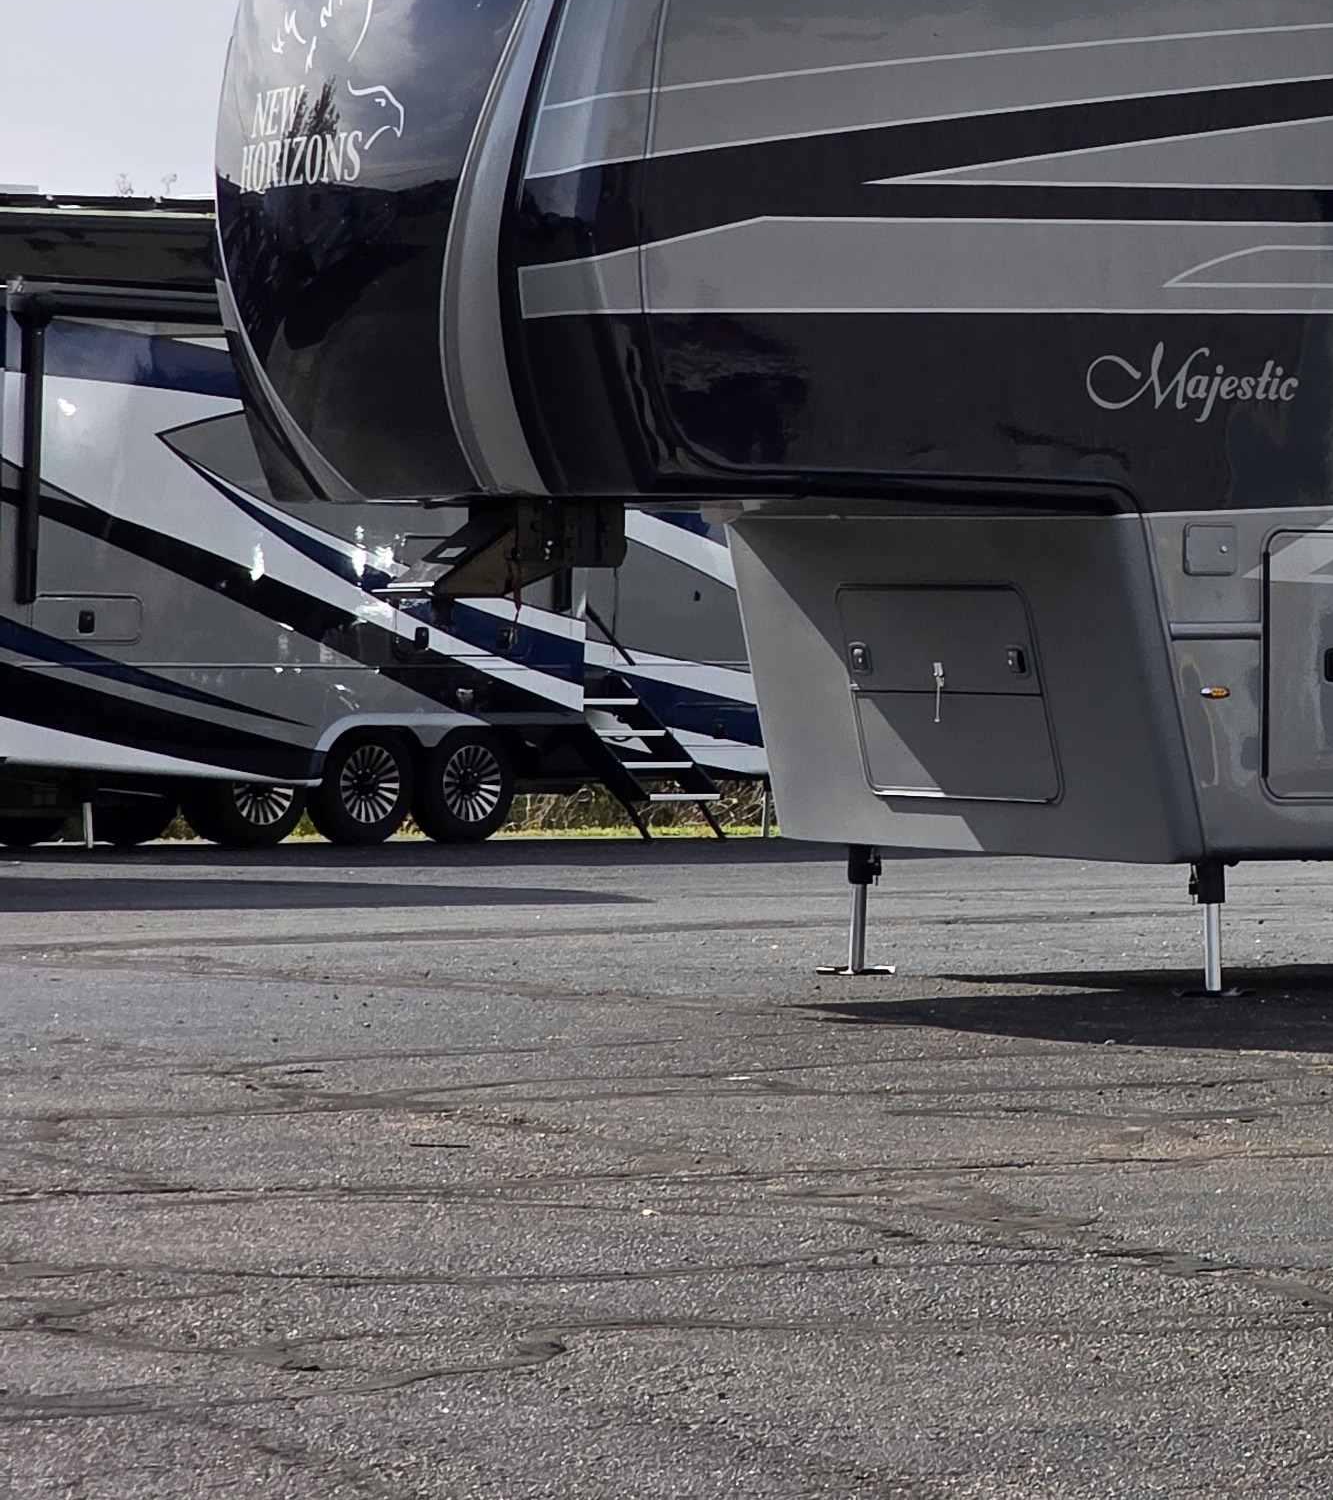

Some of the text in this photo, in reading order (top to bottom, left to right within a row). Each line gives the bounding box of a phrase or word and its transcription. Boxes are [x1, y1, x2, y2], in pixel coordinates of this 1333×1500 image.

[250, 84, 306, 139] NEW
[239, 130, 363, 195] HORIZONS
[1086, 341, 1299, 423] Majestic
